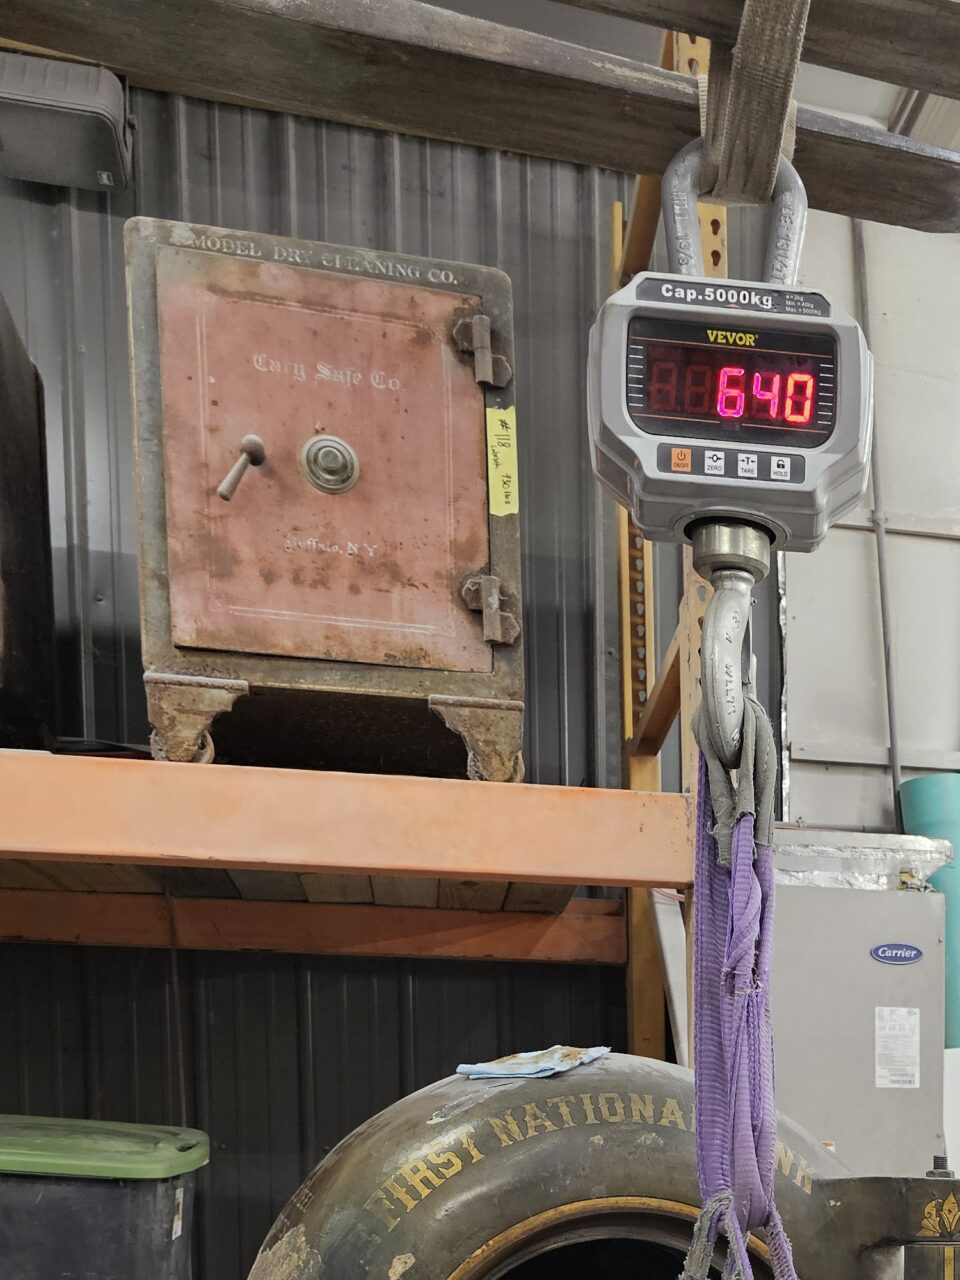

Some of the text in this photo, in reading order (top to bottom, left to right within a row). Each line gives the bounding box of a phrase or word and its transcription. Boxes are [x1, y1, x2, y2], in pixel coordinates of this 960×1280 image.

[190, 236, 459, 285] MODEL DRY CLEANING CO.
[707, 330, 756, 346] VEVOR
[252, 353, 306, 381] Cary
[315, 361, 363, 390] Safe
[717, 367, 814, 423] 640
[741, 467, 755, 475] TARE
[878, 947, 918, 958] Carrier
[363, 1124, 486, 1232] FIRST
